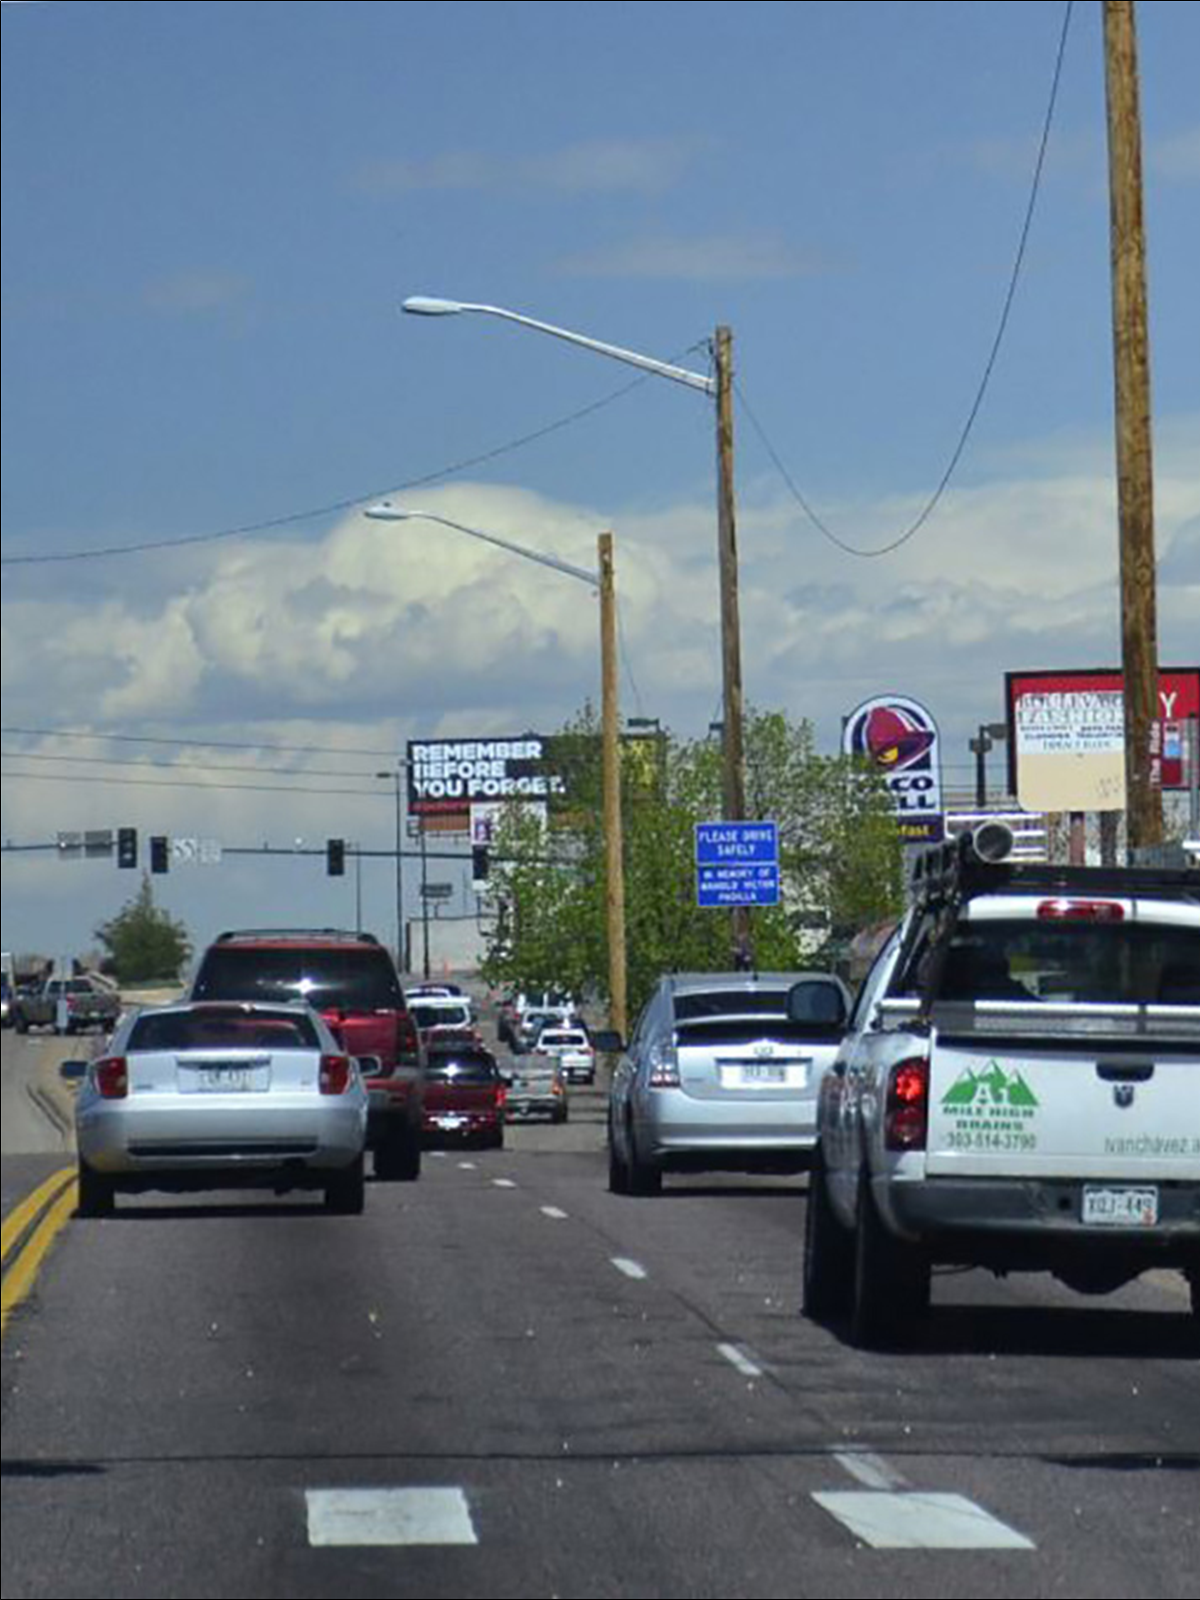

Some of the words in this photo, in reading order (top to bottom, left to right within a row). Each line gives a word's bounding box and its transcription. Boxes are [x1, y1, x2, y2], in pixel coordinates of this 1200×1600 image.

[412, 741, 543, 761] REMEMBER
[413, 760, 506, 779] BEFORE
[413, 779, 462, 798] YOU
[699, 829, 738, 843] PLEASE
[743, 829, 773, 841] DRIVE
[717, 844, 755, 856] SAFELY
[943, 1106, 982, 1117] MILE
[989, 1108, 1034, 1118] HIGH
